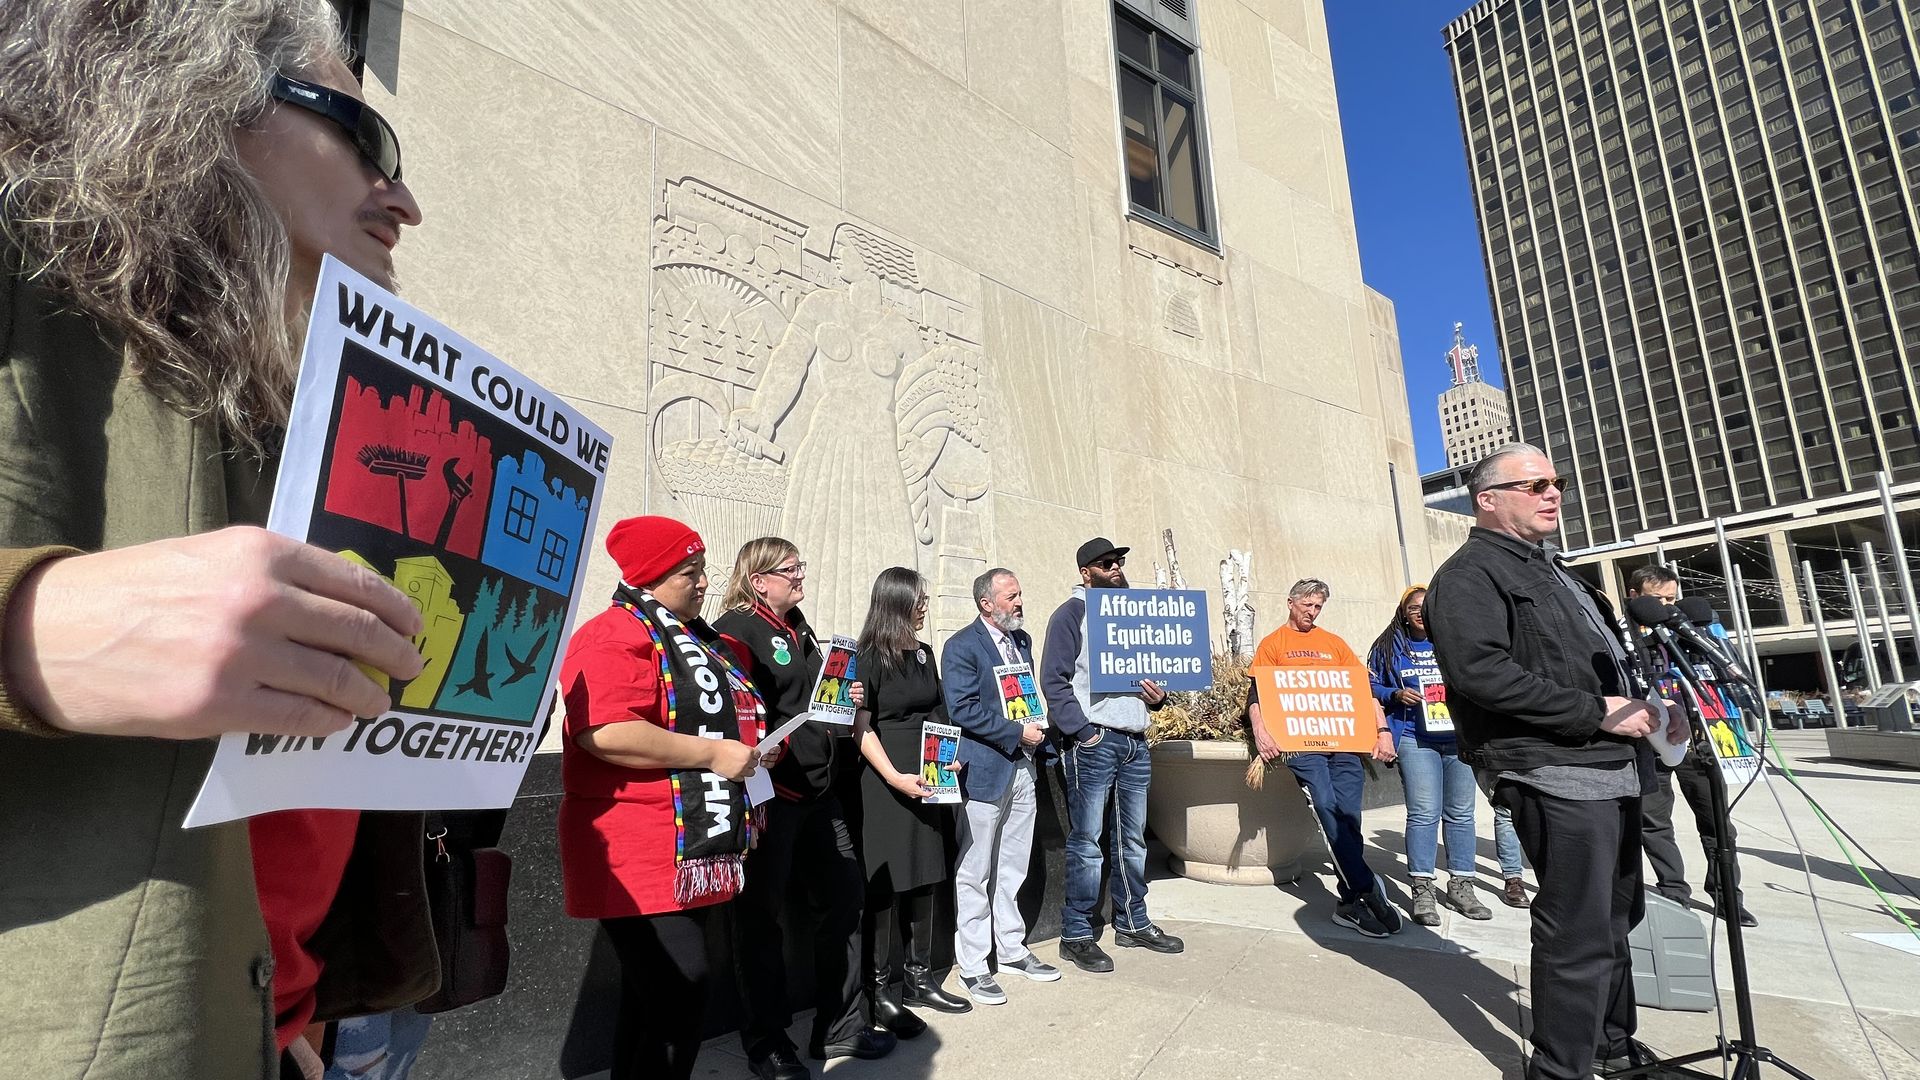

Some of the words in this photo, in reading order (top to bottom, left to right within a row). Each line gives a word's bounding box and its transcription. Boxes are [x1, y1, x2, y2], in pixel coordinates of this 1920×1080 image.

[337, 281, 462, 384] WHAT
[471, 365, 570, 447] COULD
[576, 426, 610, 474] WE
[1100, 594, 1196, 617] Affordable
[1106, 623, 1193, 650] Equitable
[1100, 652, 1202, 675] Healthcare
[1274, 670, 1352, 689] RESTORE
[811, 702, 824, 712] WIN
[1279, 693, 1355, 712] WORKER
[1286, 717, 1355, 737] DIGNITY
[698, 725, 731, 838] WHT
